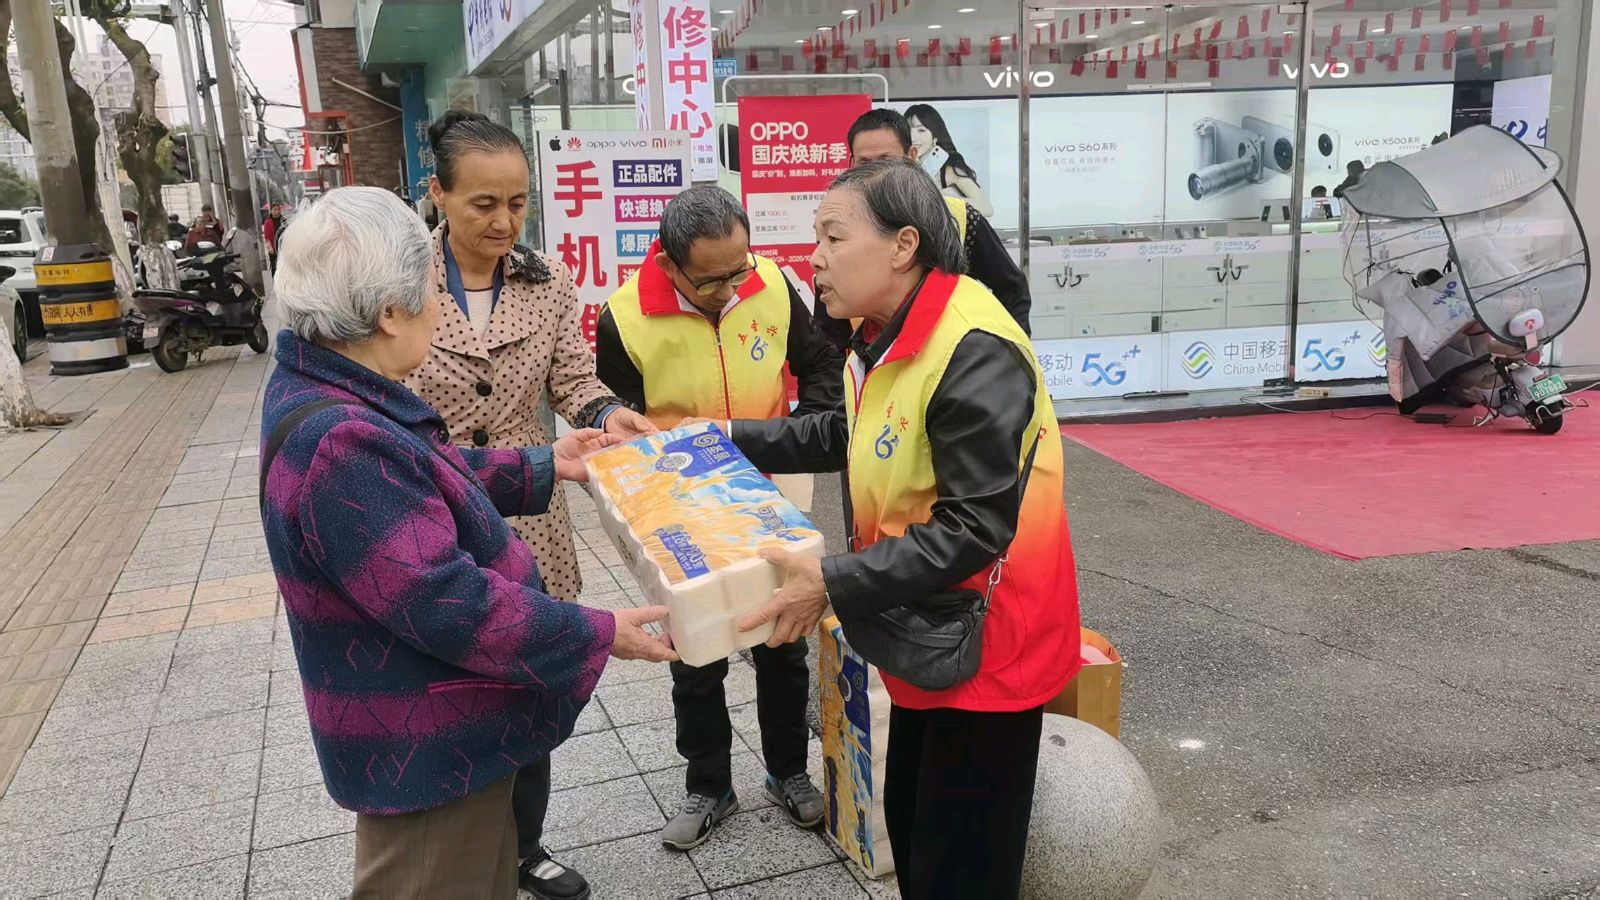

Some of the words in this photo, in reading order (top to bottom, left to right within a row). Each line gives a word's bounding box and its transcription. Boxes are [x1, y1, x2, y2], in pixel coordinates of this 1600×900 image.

[632, 0, 650, 130] 修中心
[1283, 62, 1350, 80] vvo
[750, 121, 809, 141] OPPO
[620, 139, 647, 148] vivo
[1045, 143, 1076, 153] vivo
[752, 142, 848, 165] 国庆焕新季
[618, 164, 678, 183] 正品配件
[620, 199, 669, 218] 快速换
[621, 234, 659, 253] 爆屏
[1223, 361, 1255, 375] China
[1042, 373, 1073, 387] obile
